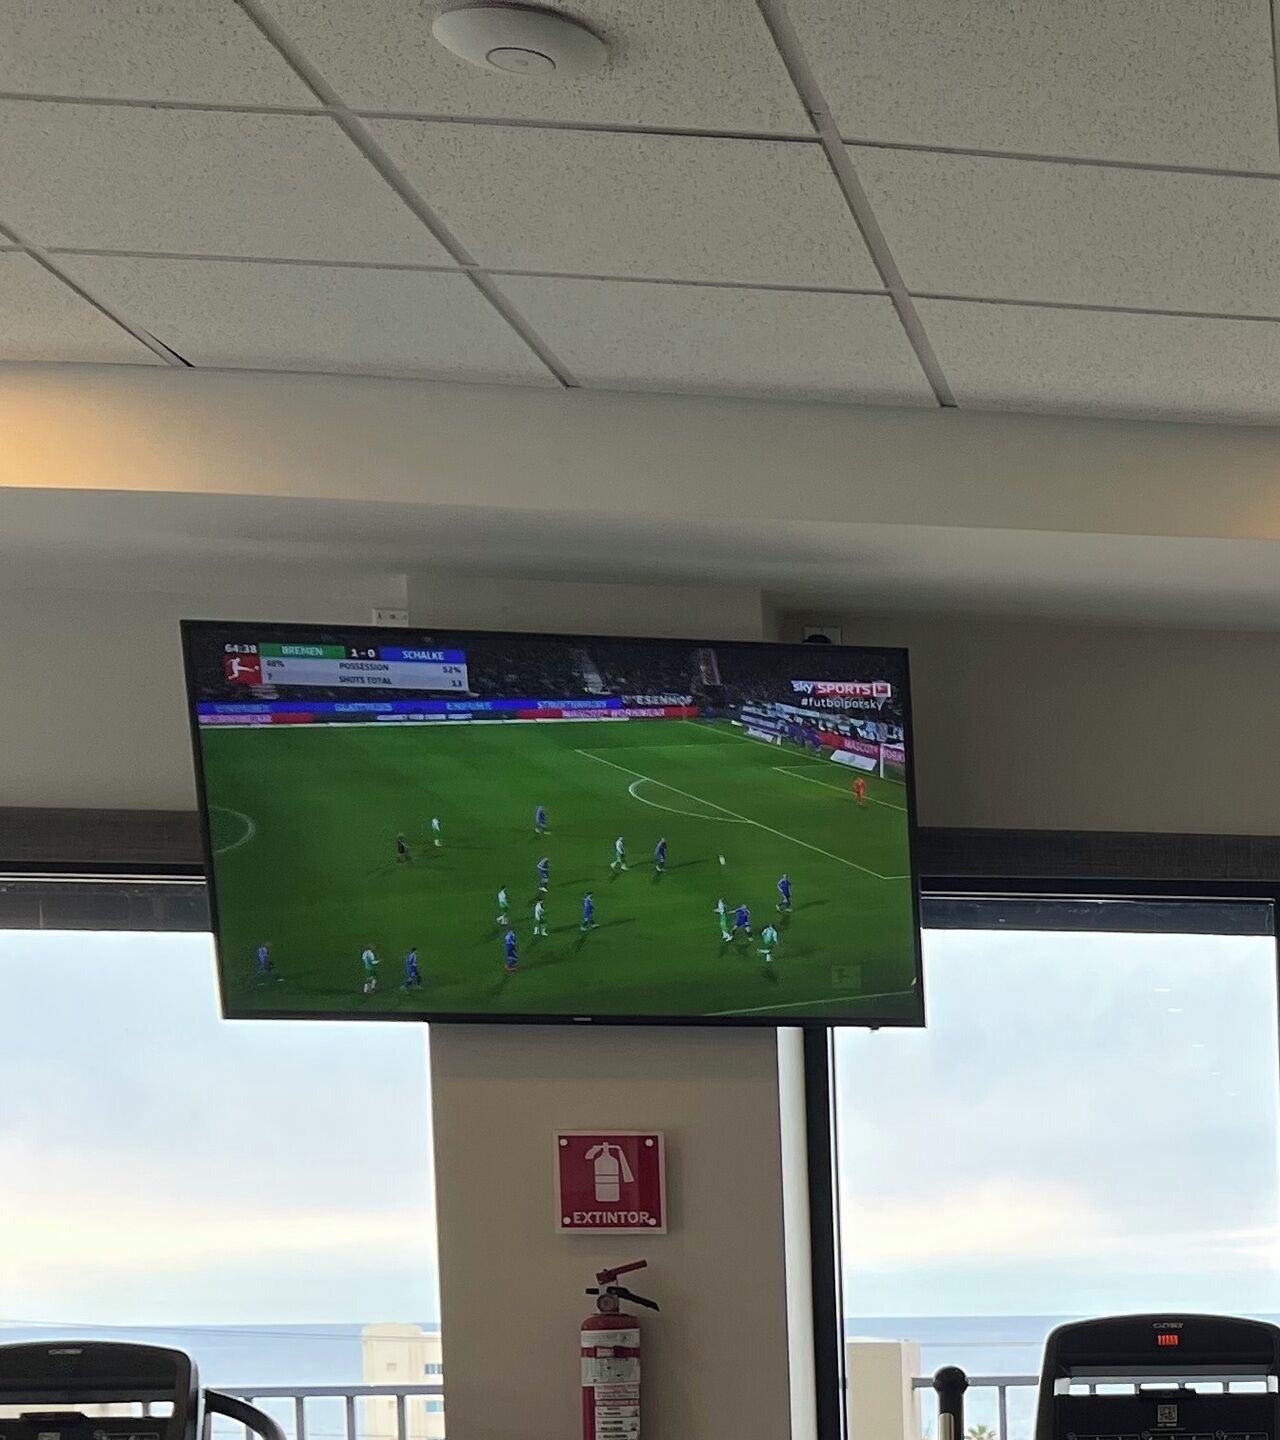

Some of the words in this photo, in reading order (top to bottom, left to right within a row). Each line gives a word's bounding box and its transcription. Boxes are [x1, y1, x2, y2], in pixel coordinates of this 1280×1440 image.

[281, 645, 324, 656] BREMEN
[367, 648, 376, 658] 0
[401, 650, 445, 661] SCHALKE
[339, 662, 390, 672] POSSESSION
[339, 675, 366, 685] SHOTS
[367, 677, 393, 686] TOTAL
[792, 681, 814, 694] sky
[816, 683, 872, 696] SPORTS
[573, 1211, 650, 1224] EXTINTOR
